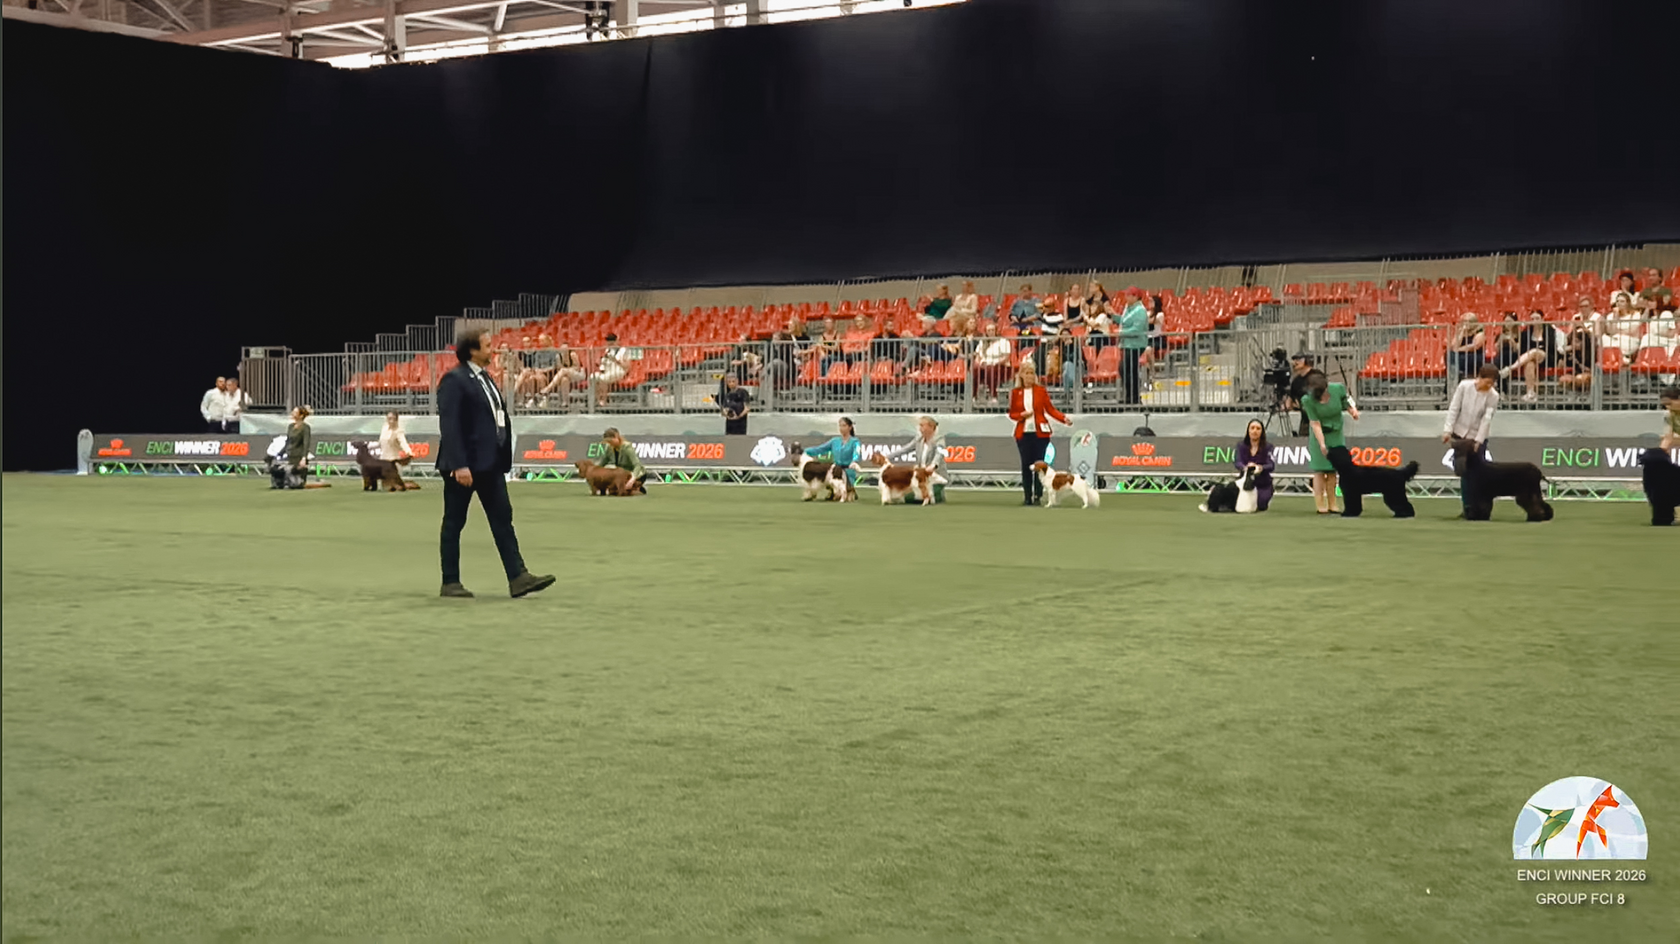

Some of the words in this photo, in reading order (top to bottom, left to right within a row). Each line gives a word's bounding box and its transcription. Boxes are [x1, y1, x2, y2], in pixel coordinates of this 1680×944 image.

[146, 441, 175, 455] ENCI
[174, 441, 221, 455] WINNER
[220, 442, 249, 456] 2026
[316, 441, 345, 455] ENCI
[686, 443, 724, 459] 2026
[1350, 446, 1402, 467] 2026
[1542, 447, 1599, 467] ENCI
